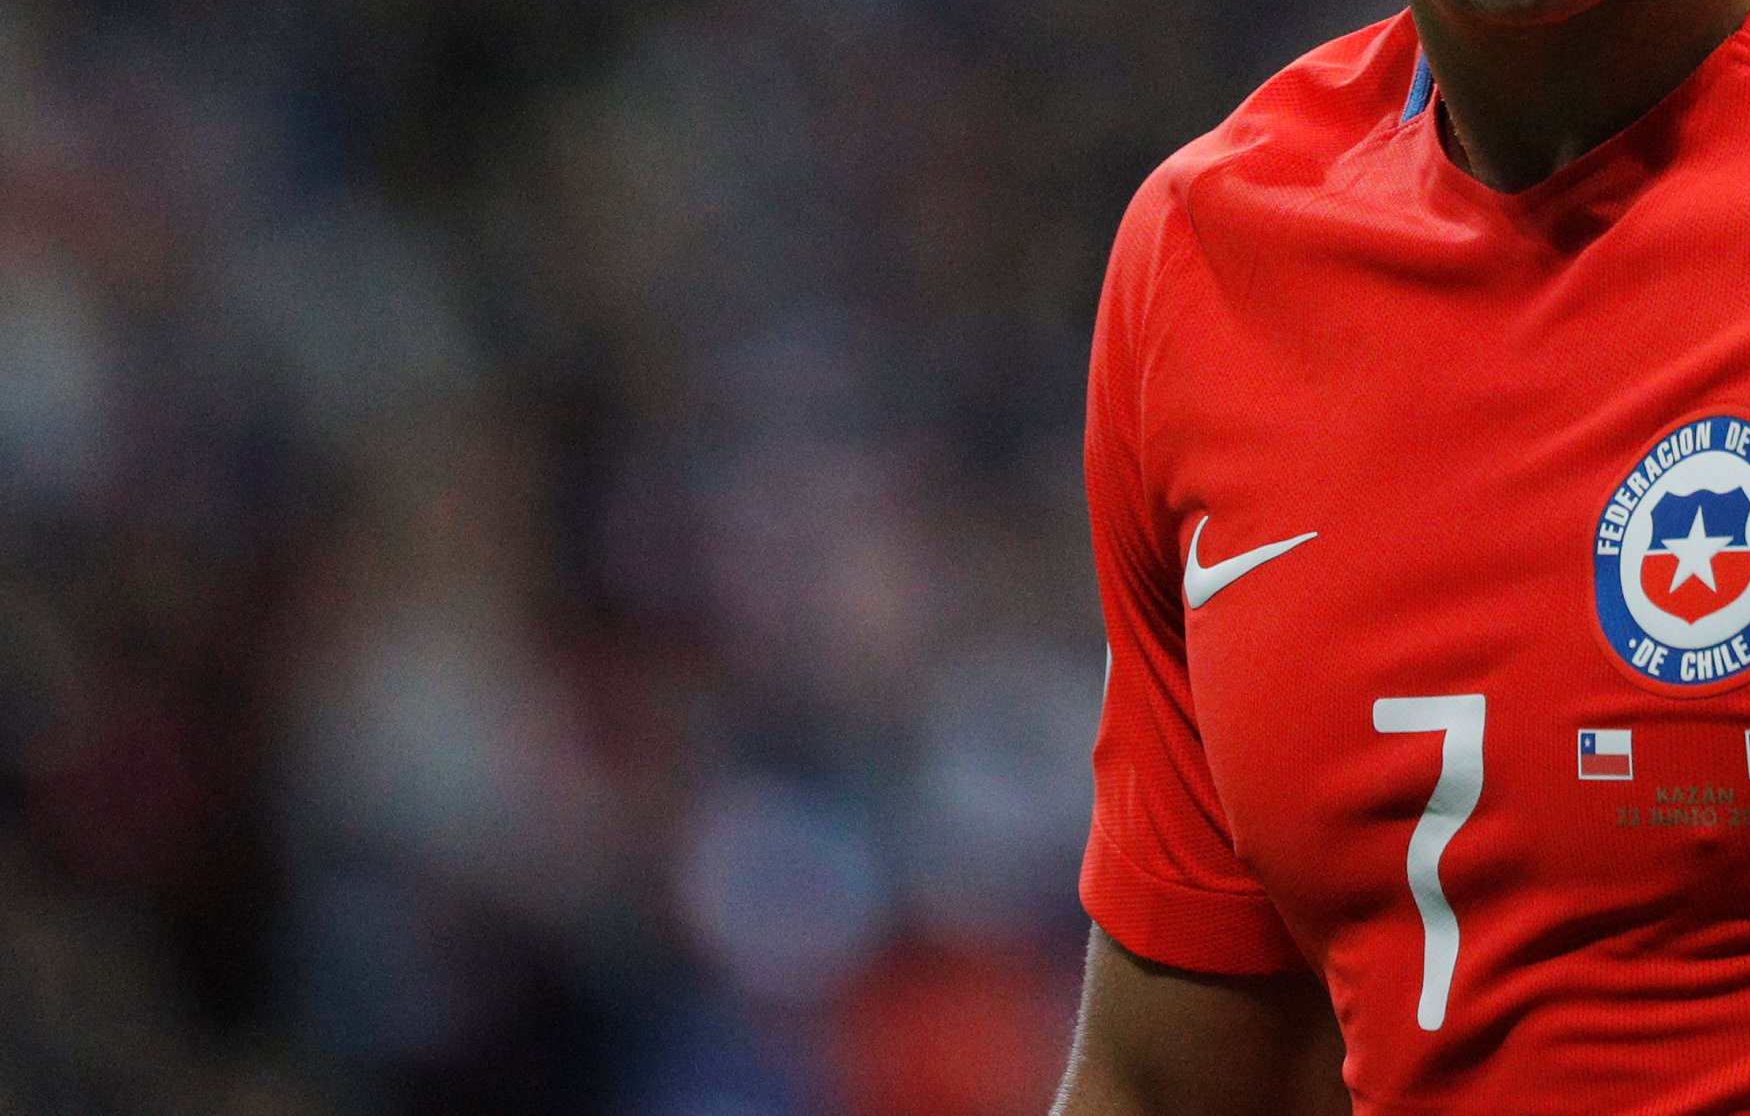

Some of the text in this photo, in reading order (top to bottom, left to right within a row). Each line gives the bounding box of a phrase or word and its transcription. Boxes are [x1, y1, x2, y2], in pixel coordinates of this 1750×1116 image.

[1597, 421, 1712, 555] FEDERACION
[1631, 638, 1668, 675] DE
[1648, 807, 1718, 826] JUNIO
[1373, 693, 1486, 1031] 7
